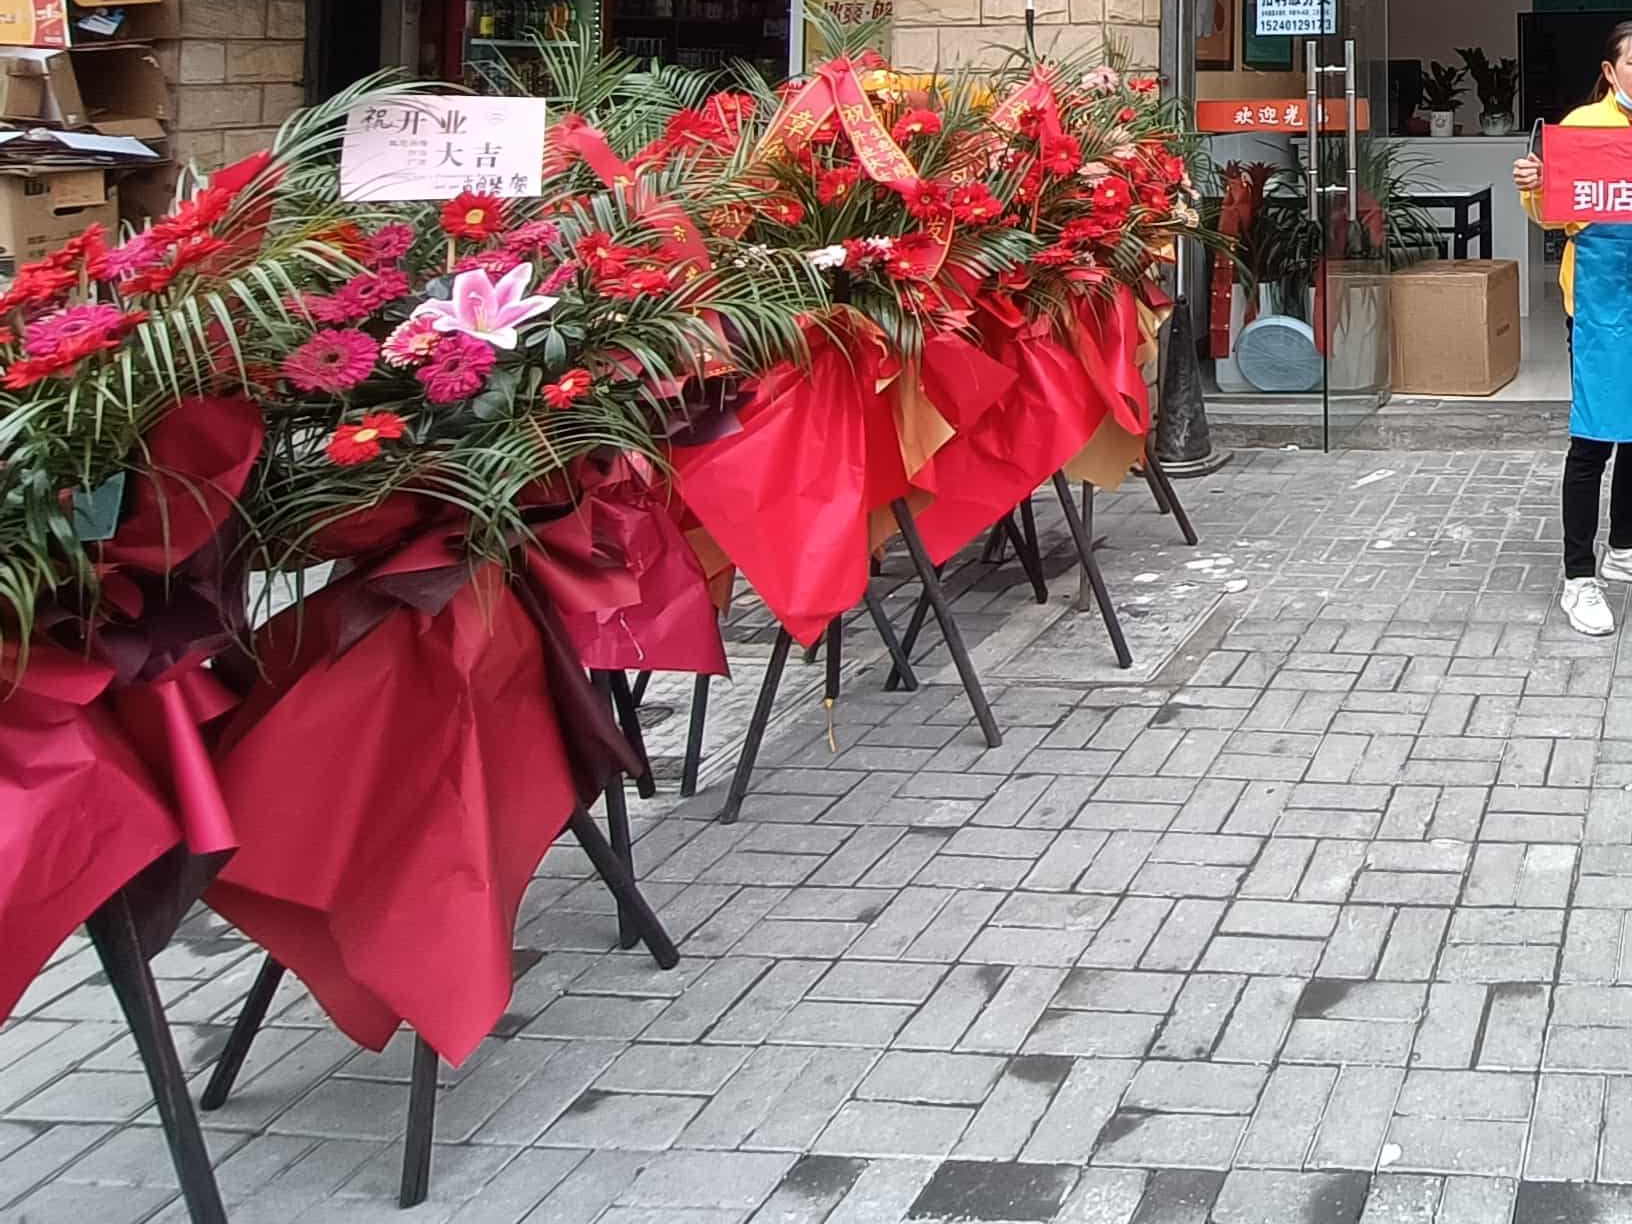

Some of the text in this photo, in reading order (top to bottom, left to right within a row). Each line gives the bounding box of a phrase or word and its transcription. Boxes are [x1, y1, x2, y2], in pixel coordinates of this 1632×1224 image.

[1234, 104, 1329, 126] 欢迎光
[437, 141, 503, 168] 大吉
